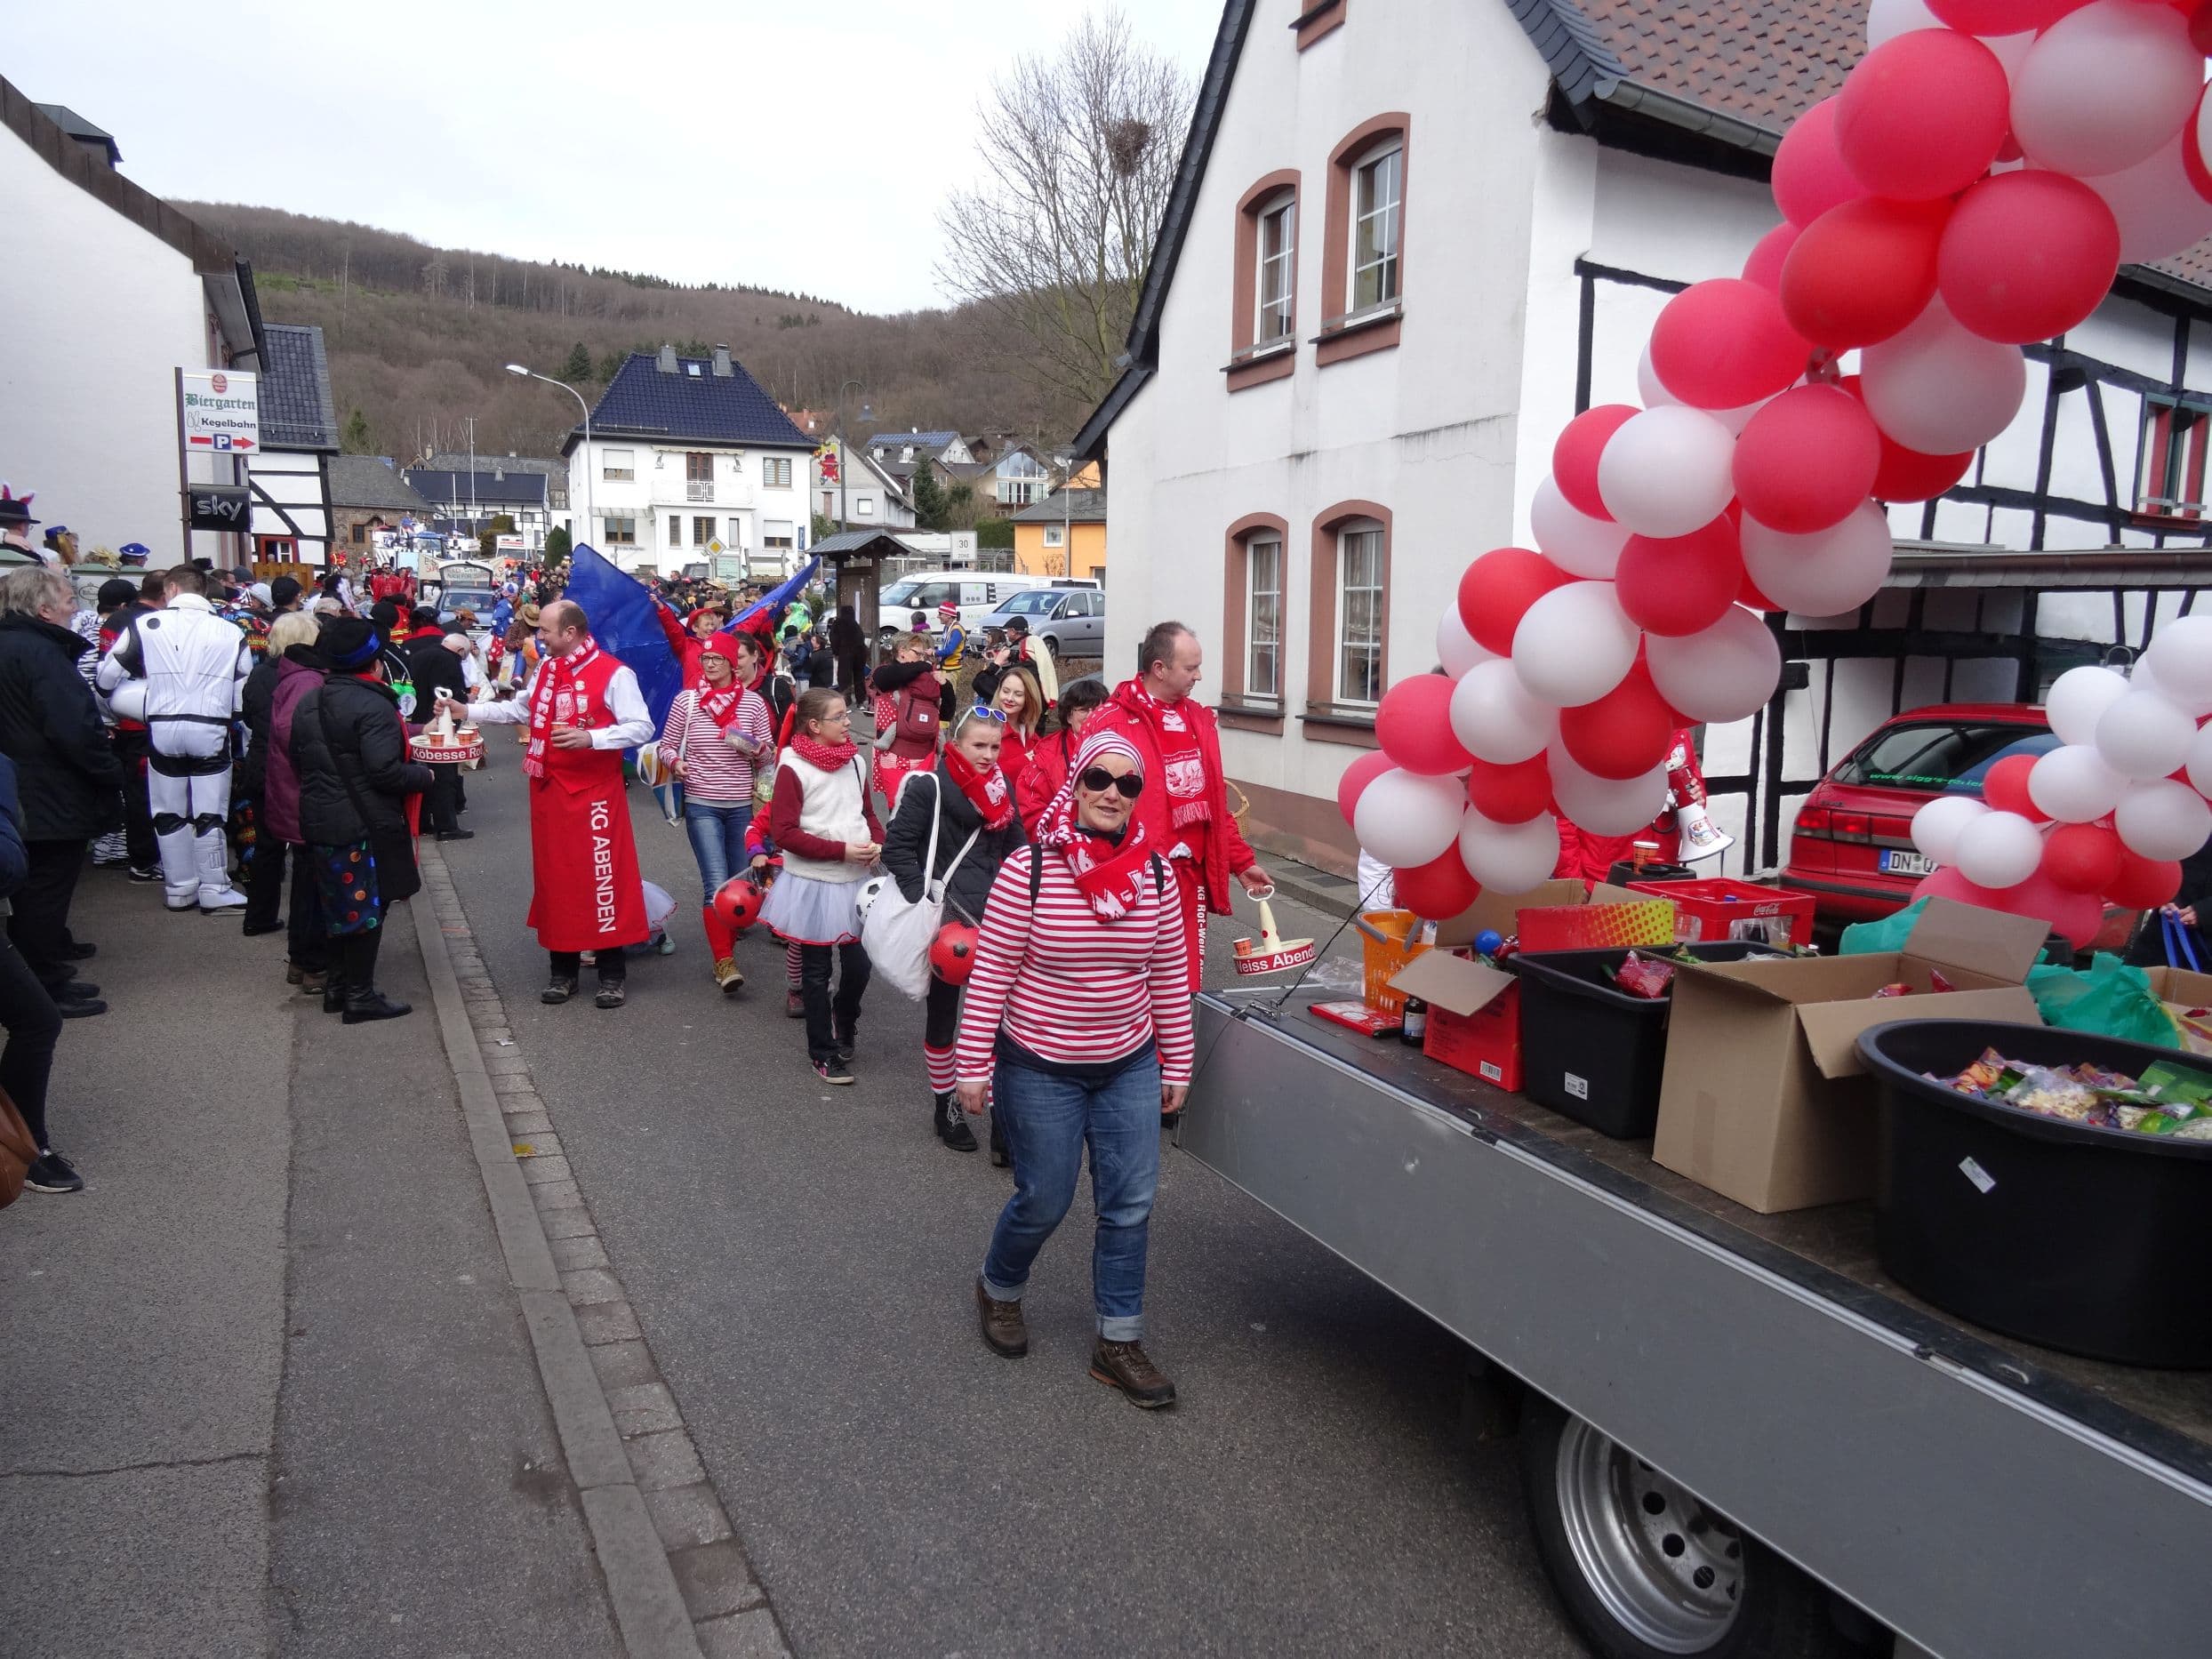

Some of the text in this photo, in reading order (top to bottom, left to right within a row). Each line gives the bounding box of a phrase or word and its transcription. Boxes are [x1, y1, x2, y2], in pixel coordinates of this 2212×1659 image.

[185, 393, 256, 410] Biergarten
[201, 417, 257, 429] Kegelbahn
[216, 436, 229, 449] P
[196, 494, 243, 521] sky
[958, 540, 969, 549] 30
[413, 747, 467, 760] Köbesse
[590, 800, 616, 934] KG ABENDEN
[1891, 853, 1911, 870] DN
[1197, 886, 1206, 901] KG
